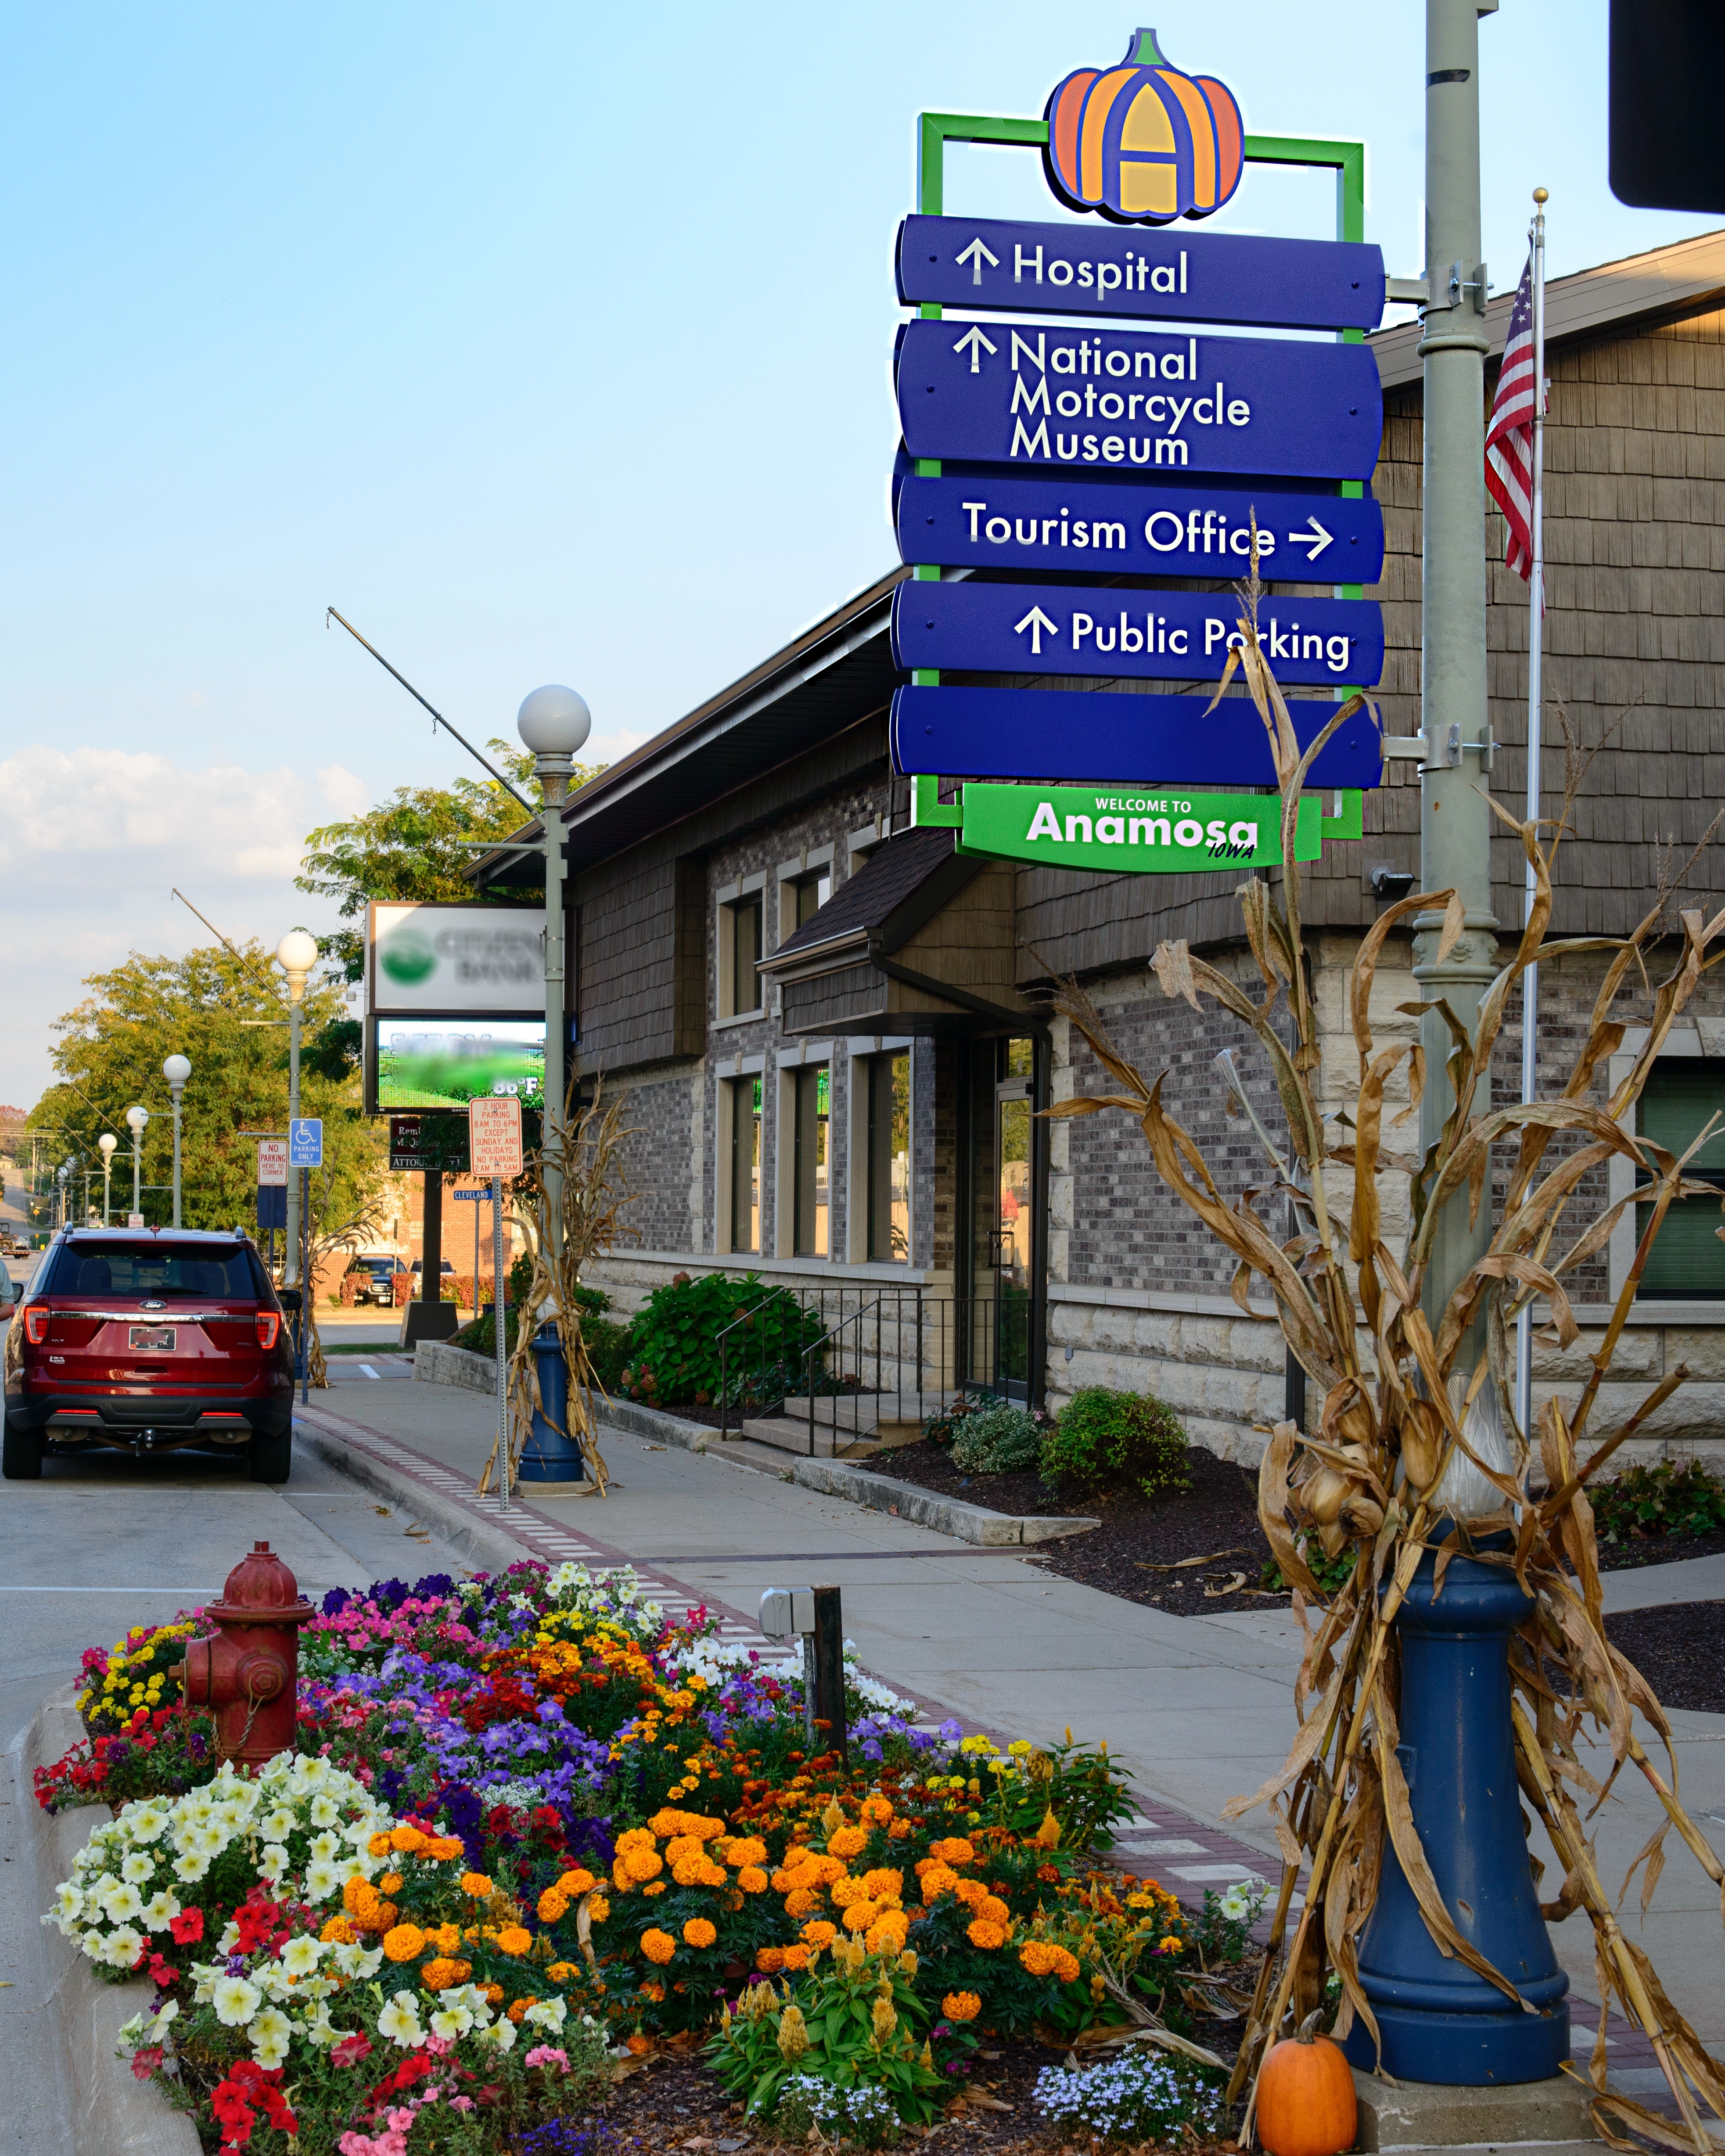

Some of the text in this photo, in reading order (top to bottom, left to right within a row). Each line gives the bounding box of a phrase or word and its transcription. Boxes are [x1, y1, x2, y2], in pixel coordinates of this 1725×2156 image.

[1015, 244, 1187, 301] Hospital
[1011, 329, 1197, 380] National
[1010, 373, 1250, 435] Motorcycle
[1010, 416, 1188, 465] Museum
[962, 502, 1275, 556] Tourism Office
[1073, 612, 1349, 672] Public Parking
[1026, 802, 1258, 849] Anamosa
[1095, 798, 1191, 813] WELCOME TO
[1208, 842, 1255, 859] IOWA
[261, 1154, 286, 1163] PARKING
[268, 1144, 278, 1153] NO
[455, 1191, 489, 1199] CLEVELAND
